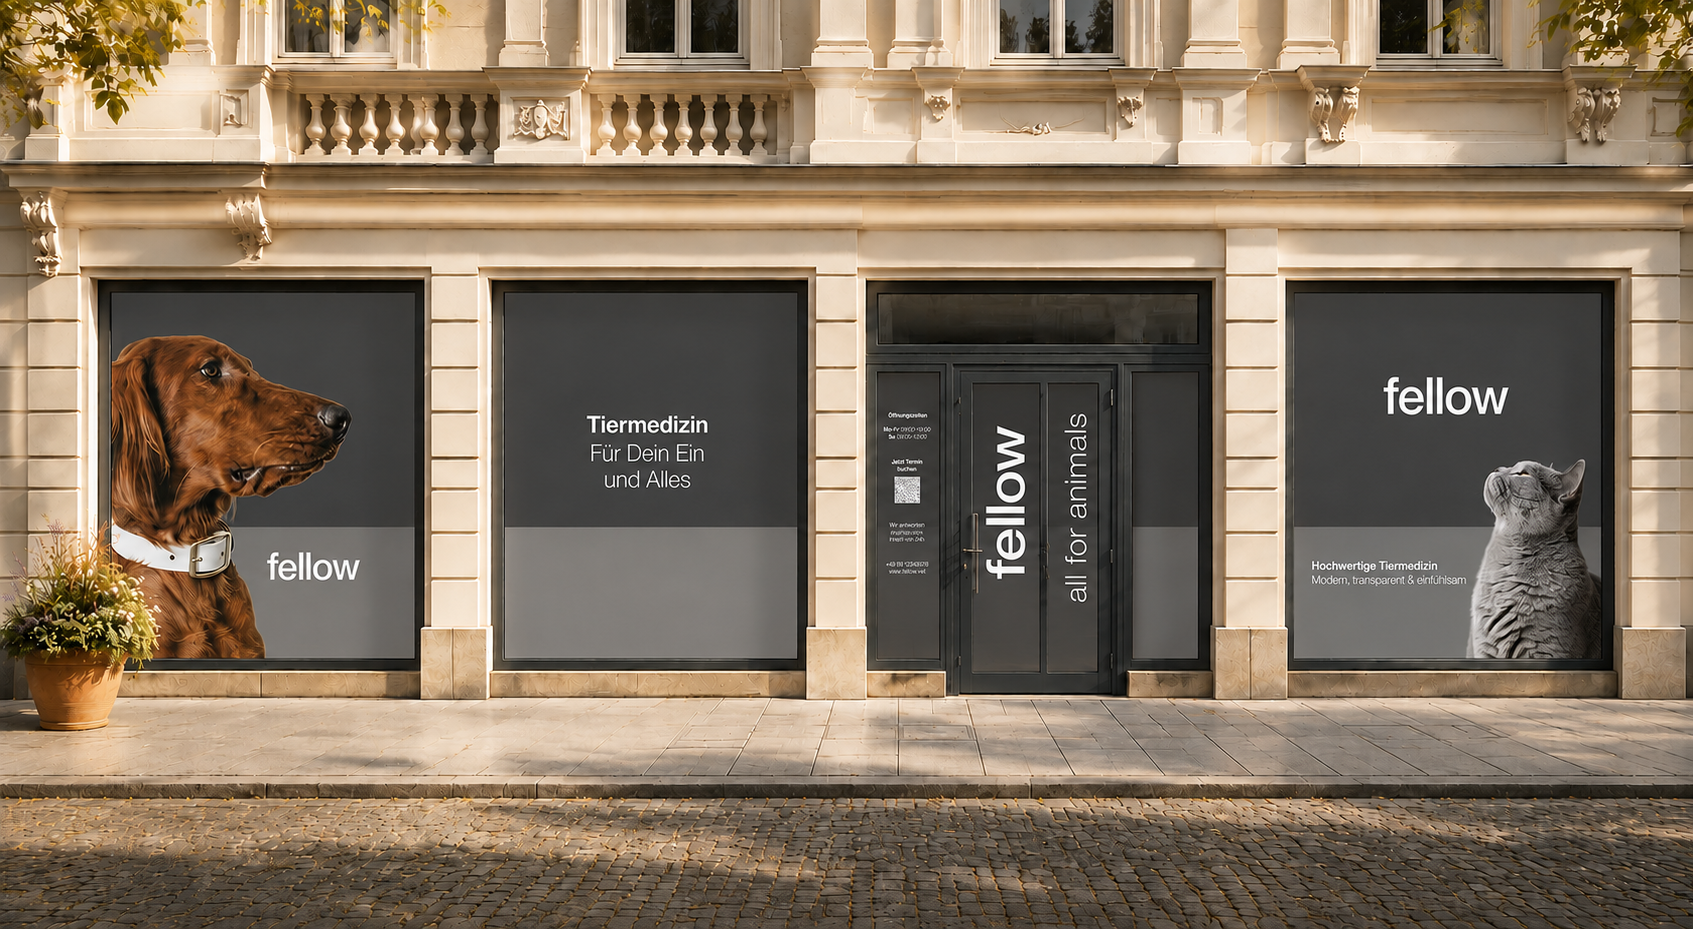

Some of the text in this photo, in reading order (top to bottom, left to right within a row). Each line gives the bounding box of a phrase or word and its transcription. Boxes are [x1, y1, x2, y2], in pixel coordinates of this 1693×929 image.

[1383, 377, 1510, 416] fellow
[586, 415, 709, 434] Tiermedizin
[590, 443, 705, 462] Für Dein Ein
[604, 470, 691, 489] und Alles
[985, 425, 1026, 580] fellow
[1063, 413, 1088, 603] all for animals
[267, 552, 361, 581] fellow
[1311, 560, 1438, 573] Hochwertige Tiermedizin
[1311, 575, 1467, 587] Modern, transparent & einfühlsam
